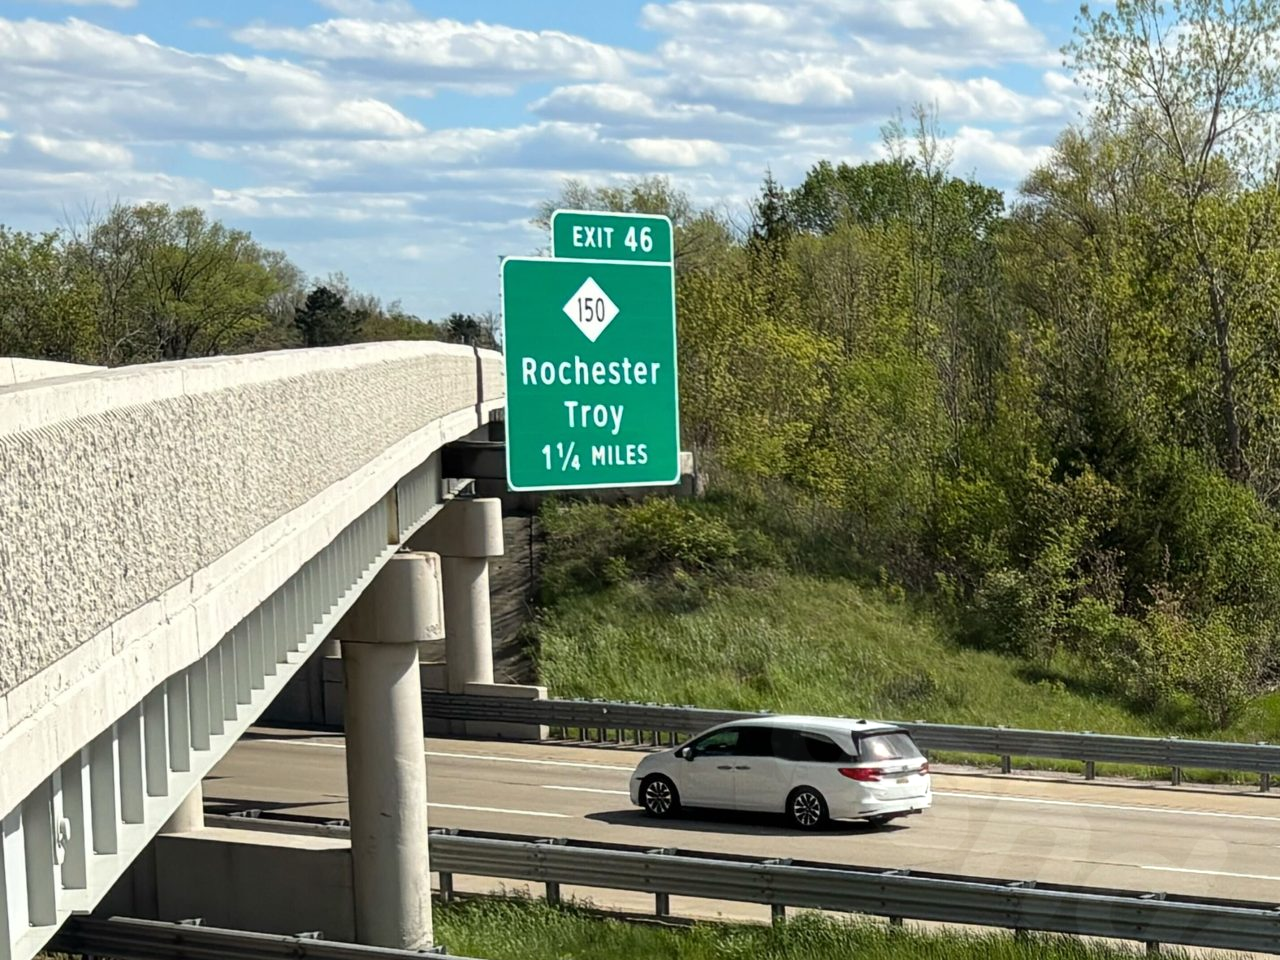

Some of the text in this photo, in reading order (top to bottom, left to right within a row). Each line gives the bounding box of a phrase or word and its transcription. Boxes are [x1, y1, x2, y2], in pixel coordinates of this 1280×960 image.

[572, 225, 653, 252] EXIT 46
[577, 297, 605, 322] 150
[521, 355, 661, 385] Rochester
[564, 400, 624, 435] Troy
[591, 443, 648, 466] MILES
